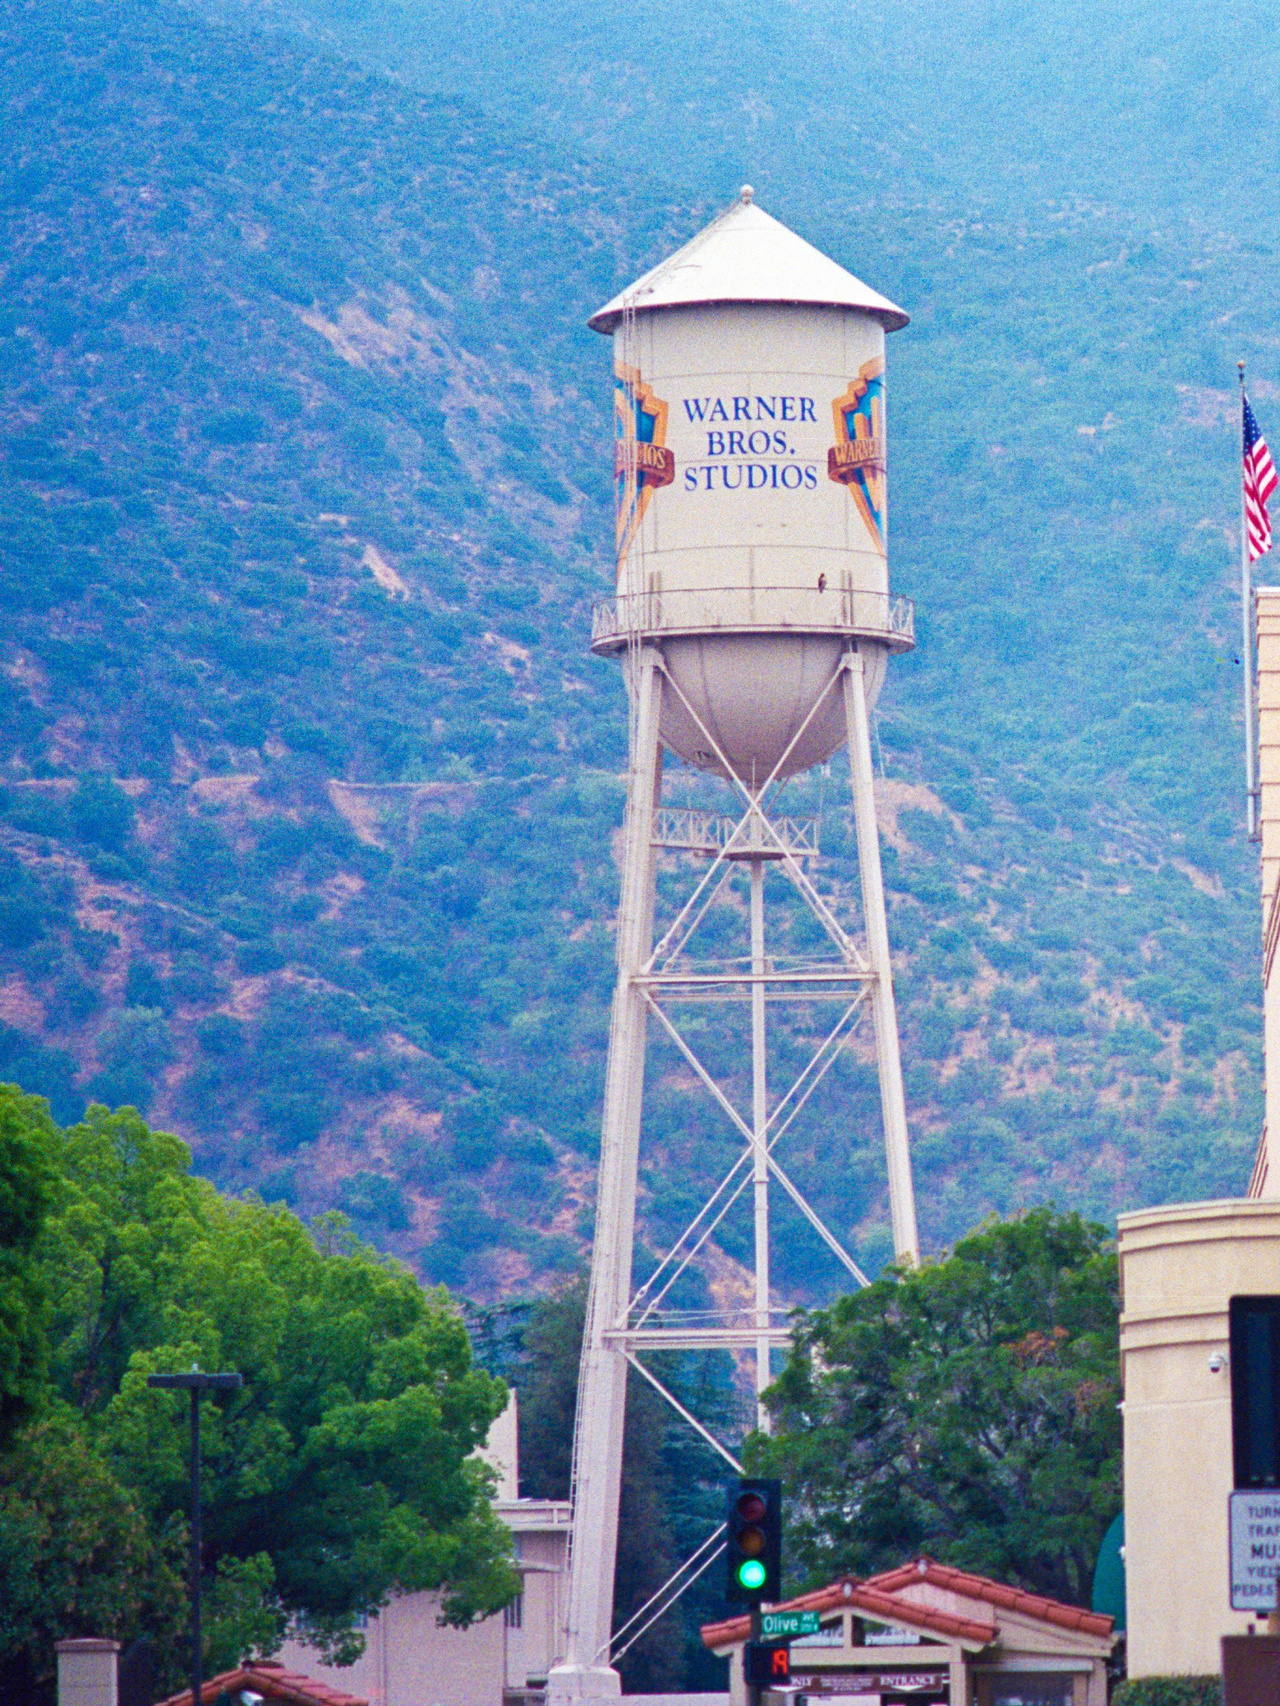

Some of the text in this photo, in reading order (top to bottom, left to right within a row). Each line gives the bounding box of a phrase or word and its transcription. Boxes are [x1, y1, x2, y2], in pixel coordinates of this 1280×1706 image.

[683, 396, 818, 423] WARNER
[706, 430, 796, 456] BROS.
[684, 464, 819, 492] STUDIOS
[763, 1615, 798, 1633] Olive
[880, 1675, 936, 1687] ENTRANCE
